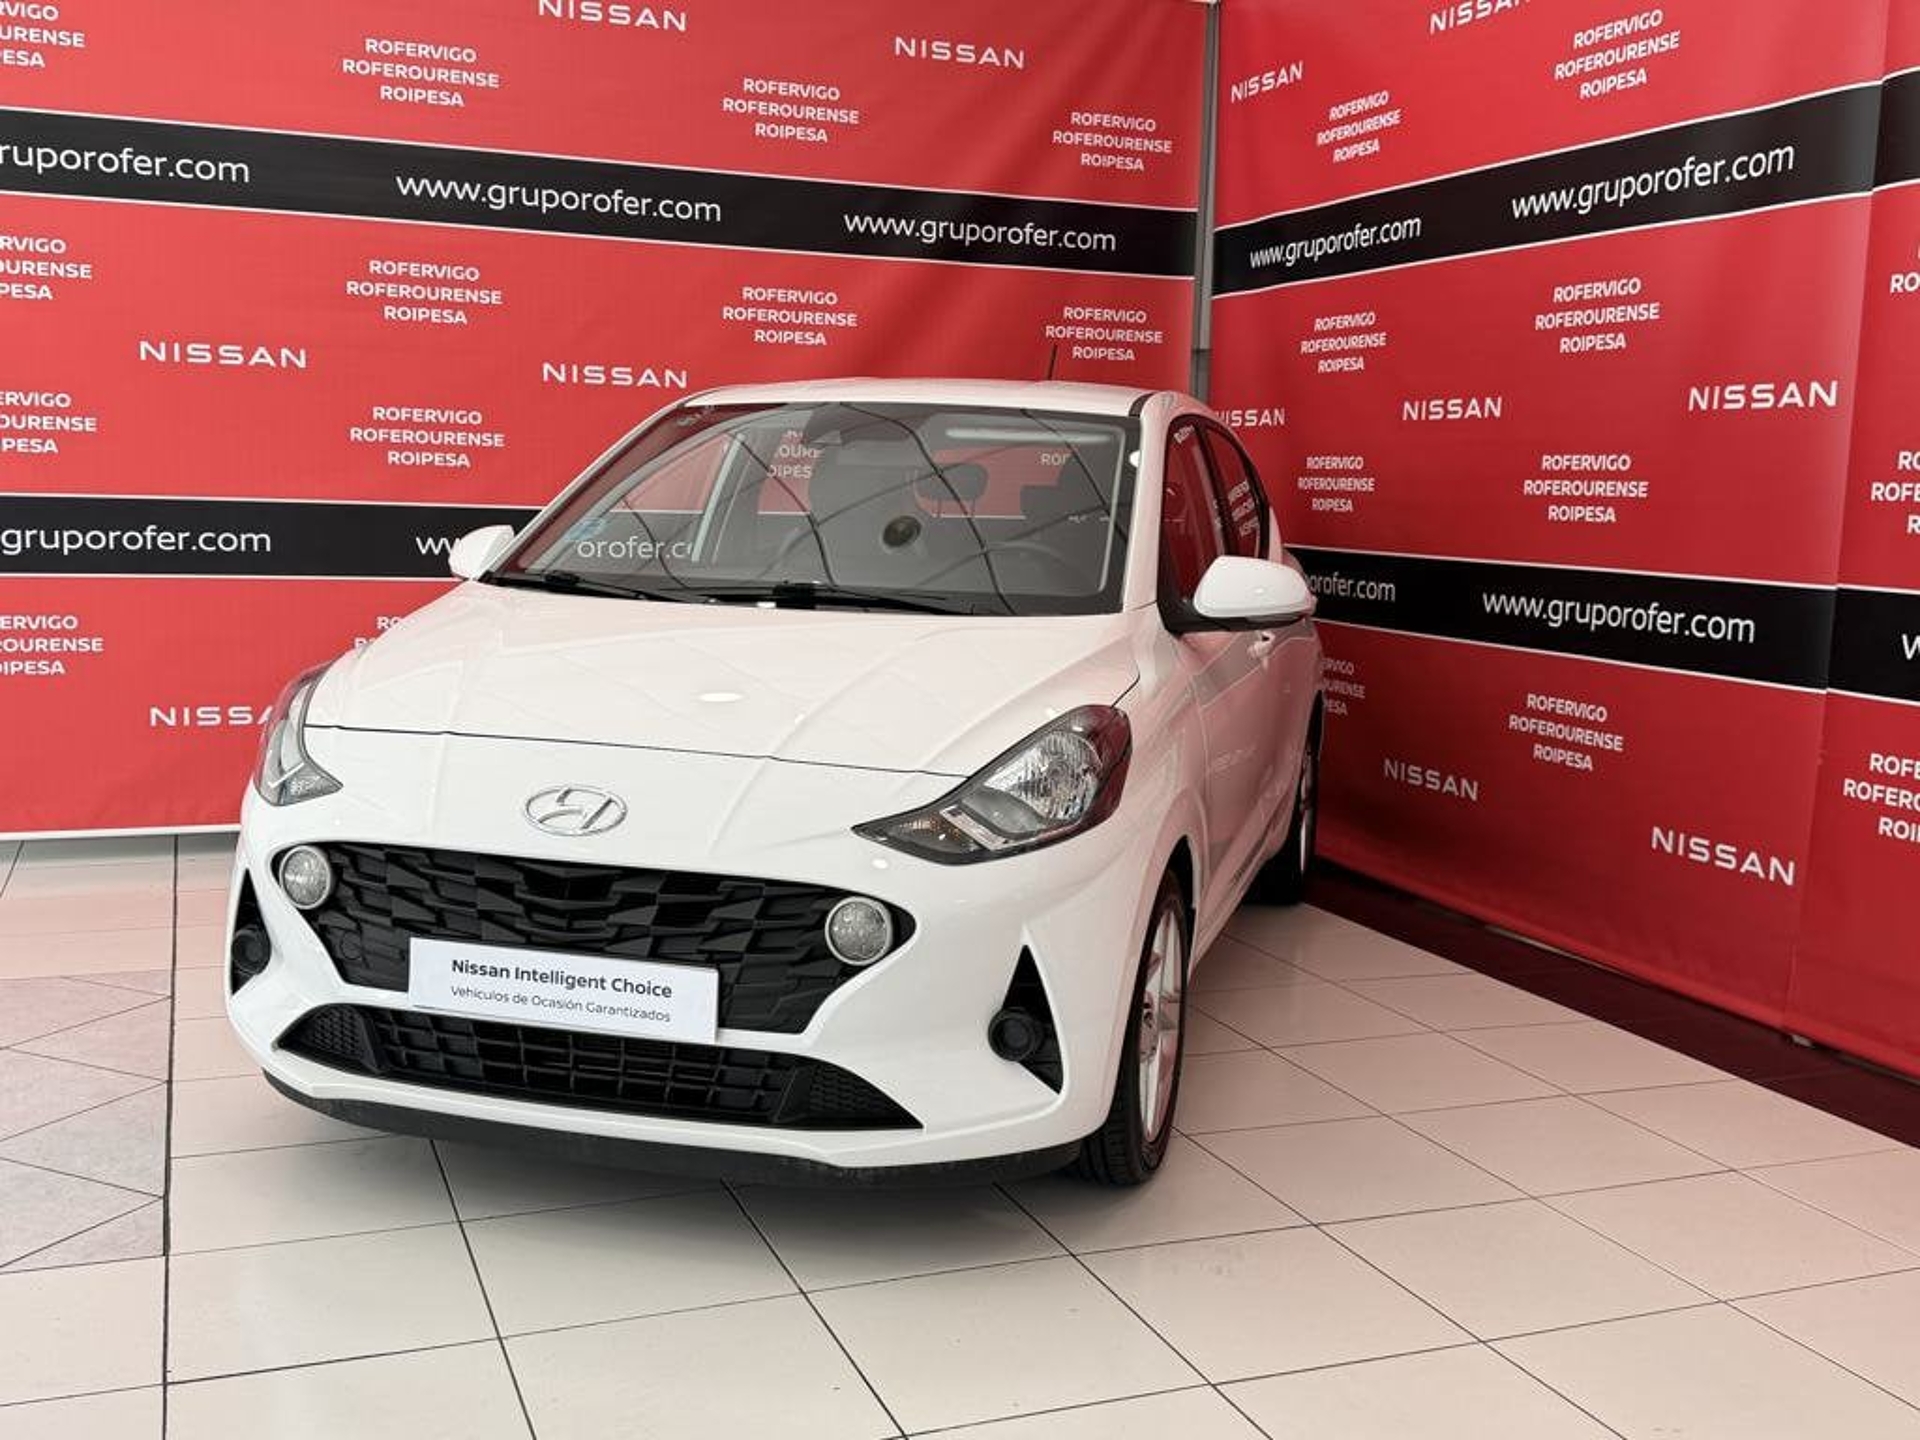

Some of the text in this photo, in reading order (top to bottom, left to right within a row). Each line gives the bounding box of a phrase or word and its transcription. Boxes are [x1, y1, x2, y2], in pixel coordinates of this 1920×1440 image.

[539, 0, 685, 31] NISSAN
[1431, 0, 1524, 32] NISSA
[1574, 10, 1663, 48] ROFERVIGO
[0, 48, 45, 68] ESA
[366, 39, 476, 62] ROFERVIGO
[896, 37, 1023, 68] NISSAN
[1555, 31, 1680, 79] ROFEROURENSE
[343, 59, 498, 87] ROFEROURENSE
[1232, 62, 1302, 102] NISSAN
[1581, 68, 1646, 98] ROIPESA
[381, 86, 463, 106] ROIPESA
[744, 78, 840, 100] ROFERVIGO
[723, 98, 858, 124] ROFEROURENSE
[1330, 91, 1388, 120] ROFERVIGO
[756, 123, 827, 142] ROIPESA
[1071, 112, 1155, 131] ROFERVIGO
[1318, 109, 1400, 144] ROFEROURENSE
[1053, 131, 1171, 153] ROFEROURENSE
[1334, 139, 1380, 161] ROIPESA
[1081, 153, 1144, 170] ROIPESA
[1513, 146, 1793, 218] www.gruporofer.com
[396, 177, 720, 221] www.gruporofer.com
[844, 215, 1115, 250] www.gruporofer.com
[1251, 218, 1421, 268] www.gruporofer.com
[370, 260, 479, 281] ROFERVIGO
[347, 281, 502, 304] ROFEROURENSE
[743, 287, 837, 305] ROFERVIGO
[1554, 278, 1641, 302] ROFERVIGO
[384, 306, 467, 324] ROIPESA
[723, 307, 857, 326] ROFEROURENSE
[1064, 307, 1146, 323] ROFERVIGO
[1314, 312, 1375, 331] ROFERVIGO
[1536, 303, 1659, 330] ROFEROURENSE
[755, 330, 826, 345] ROIPESA
[1046, 326, 1162, 343] ROFEROURENSE
[1301, 332, 1386, 353] ROFEROURENSE
[1560, 333, 1626, 352] ROIPESA
[140, 341, 306, 368] NISSAN
[1073, 346, 1134, 360] ROIPESA
[1318, 357, 1364, 372] ROIPESA
[543, 363, 686, 388] NISSAN
[1689, 381, 1837, 410] NISSAN
[373, 407, 482, 424] ROFERVIGO
[1403, 397, 1501, 420] NISSAN
[351, 428, 504, 446] ROFEROURENSE
[388, 451, 470, 467] ROIPESA
[1307, 456, 1363, 469] ROFERVIGO
[1542, 455, 1631, 470] ROFERVIGO
[1298, 477, 1374, 491] ROFEROURENSE
[1524, 480, 1648, 497] ROFEROURENSE
[1313, 498, 1353, 512] ROIPESA
[1549, 505, 1616, 522] ROIPESA
[1, 526, 270, 555] gruporofer.com
[1483, 594, 1754, 642] www.gruporofer.com
[1528, 694, 1607, 722] ROFERVIGO
[1509, 715, 1623, 751] ROFEROURENSE
[1534, 744, 1592, 771] ROIPESA
[1385, 760, 1478, 801] NISSAN
[1652, 827, 1794, 885] NISSAN
[452, 960, 671, 998] Nissan Intelligent Choice
[512, 994, 527, 1005] de
[531, 995, 582, 1010] Ocasión
[586, 1003, 670, 1022] Garantizados
